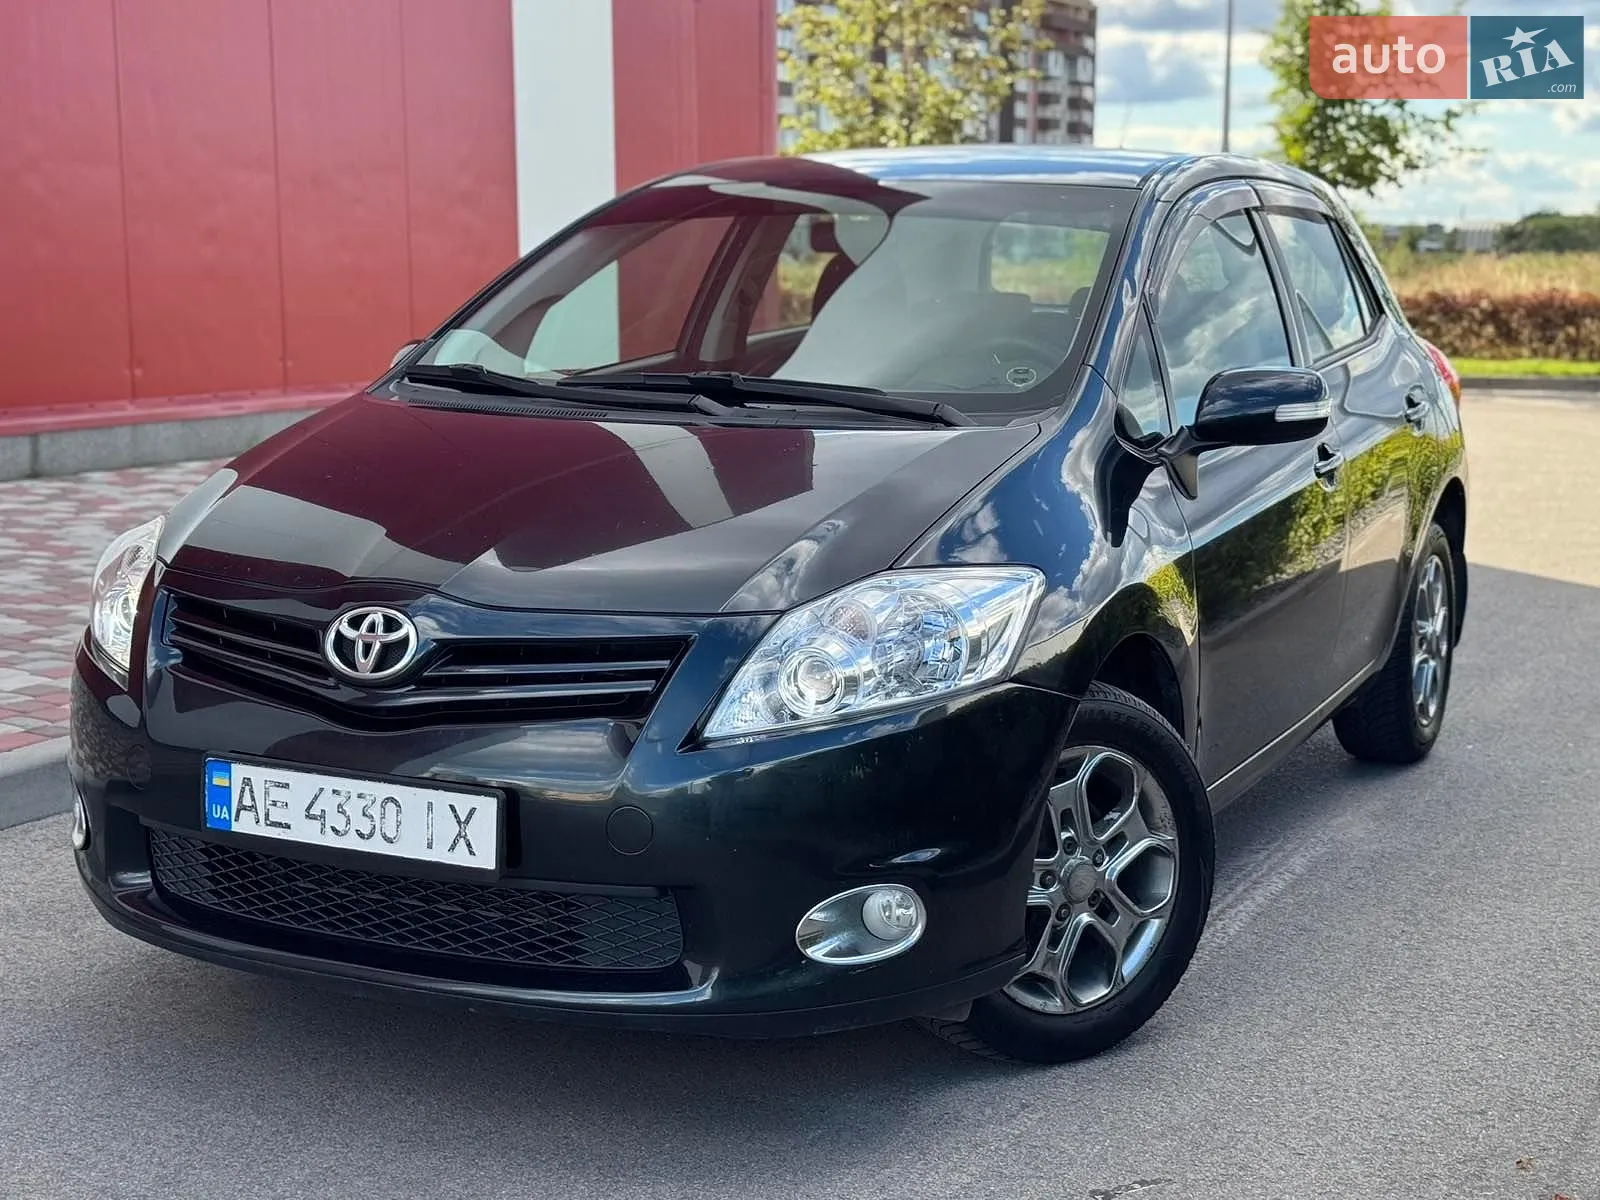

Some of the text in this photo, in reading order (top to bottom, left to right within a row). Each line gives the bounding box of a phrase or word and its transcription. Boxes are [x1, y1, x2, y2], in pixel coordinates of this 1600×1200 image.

[212, 803, 230, 820] UA
[234, 776, 478, 857] AE 4330 IX
